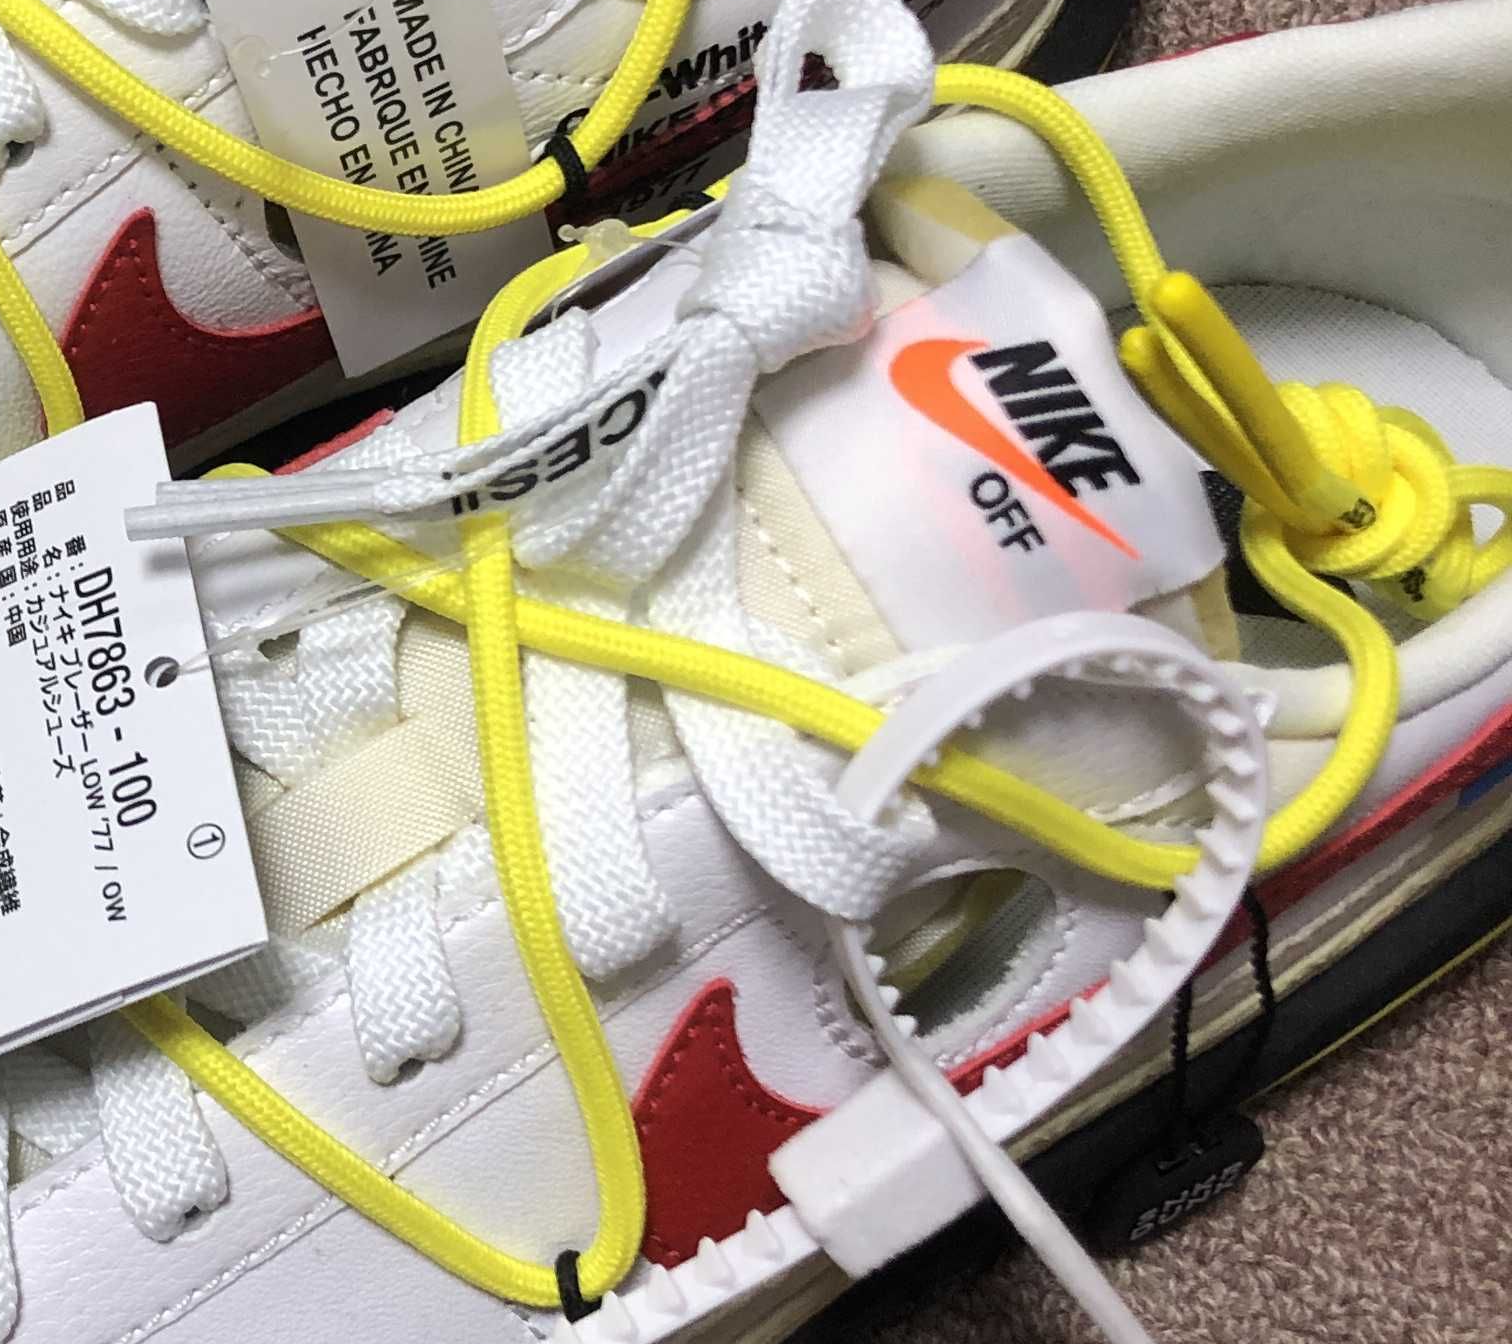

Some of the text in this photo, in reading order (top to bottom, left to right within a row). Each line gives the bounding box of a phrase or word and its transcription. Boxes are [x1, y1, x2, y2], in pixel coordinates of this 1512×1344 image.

[297, 24, 360, 142] HECHO
[340, 144, 376, 185] EN
[344, 6, 420, 166] FABRIQUE
[422, 81, 456, 118] IN
[968, 341, 1141, 497] NIKE
[970, 472, 1045, 552] OFF
[80, 758, 106, 810] LOW
[102, 881, 128, 922] OW
